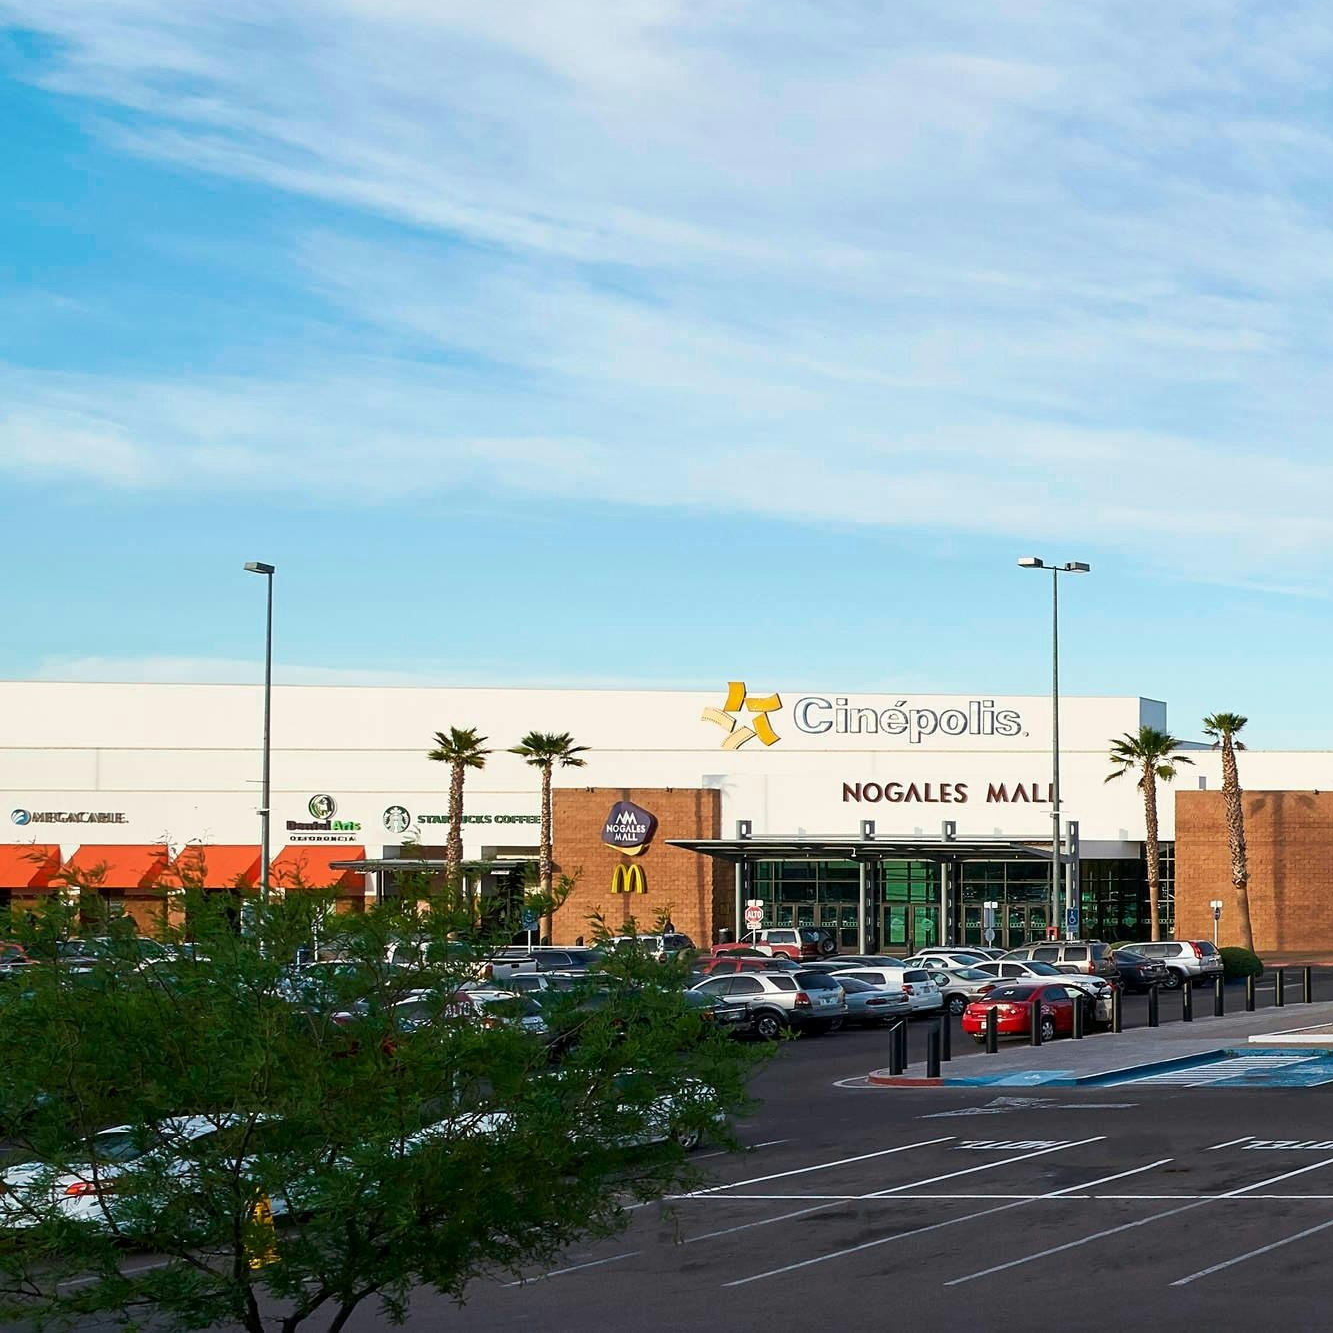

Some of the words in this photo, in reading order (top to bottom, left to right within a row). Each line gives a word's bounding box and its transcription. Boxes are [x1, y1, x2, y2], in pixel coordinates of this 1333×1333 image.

[842, 782, 969, 804] NOGALES
[986, 782, 1064, 804] MALL
[417, 815, 492, 824] STARUCKS
[494, 815, 541, 824] COFFEE
[606, 824, 646, 834] NOGALES
[614, 833, 638, 841] MALL
[747, 910, 762, 918] ALTO
